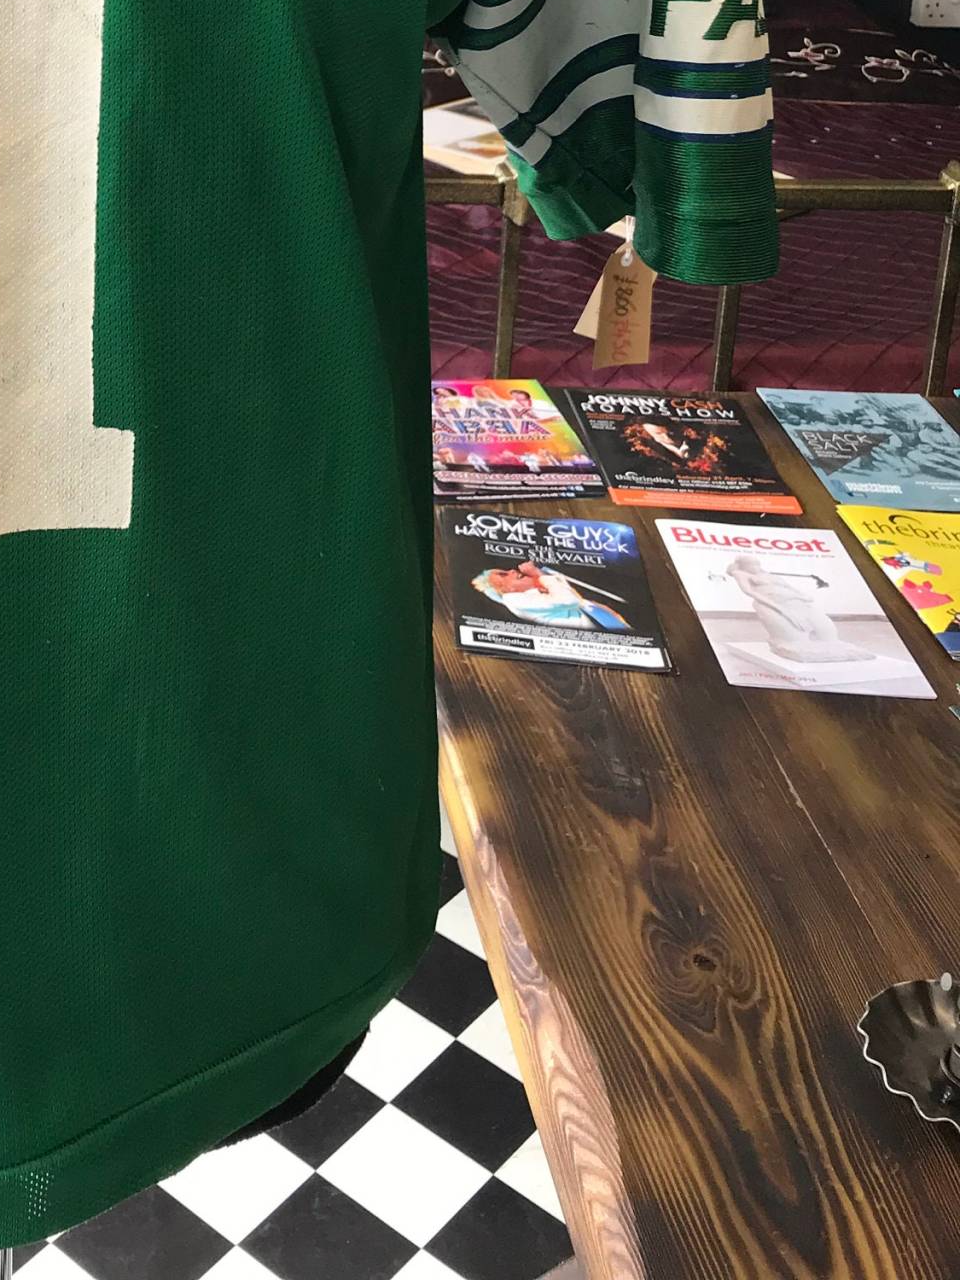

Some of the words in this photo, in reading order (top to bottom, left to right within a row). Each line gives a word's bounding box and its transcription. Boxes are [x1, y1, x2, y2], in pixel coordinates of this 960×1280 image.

[580, 402, 735, 419] ROADSHOW
[587, 394, 667, 408] JOHNNY
[670, 398, 724, 410] CASH
[802, 431, 872, 445] BLACK
[807, 439, 859, 452] SALT
[466, 513, 537, 536] SOME
[547, 523, 615, 543] GUYS
[454, 524, 499, 540] HAVE
[506, 533, 537, 545] ALL
[544, 536, 577, 550] THE
[583, 541, 629, 554] LUCK
[670, 526, 832, 553] Bluecoat
[484, 543, 524, 556] ROD
[527, 549, 606, 566] STEWART
[572, 642, 623, 652] FEBRUARY
